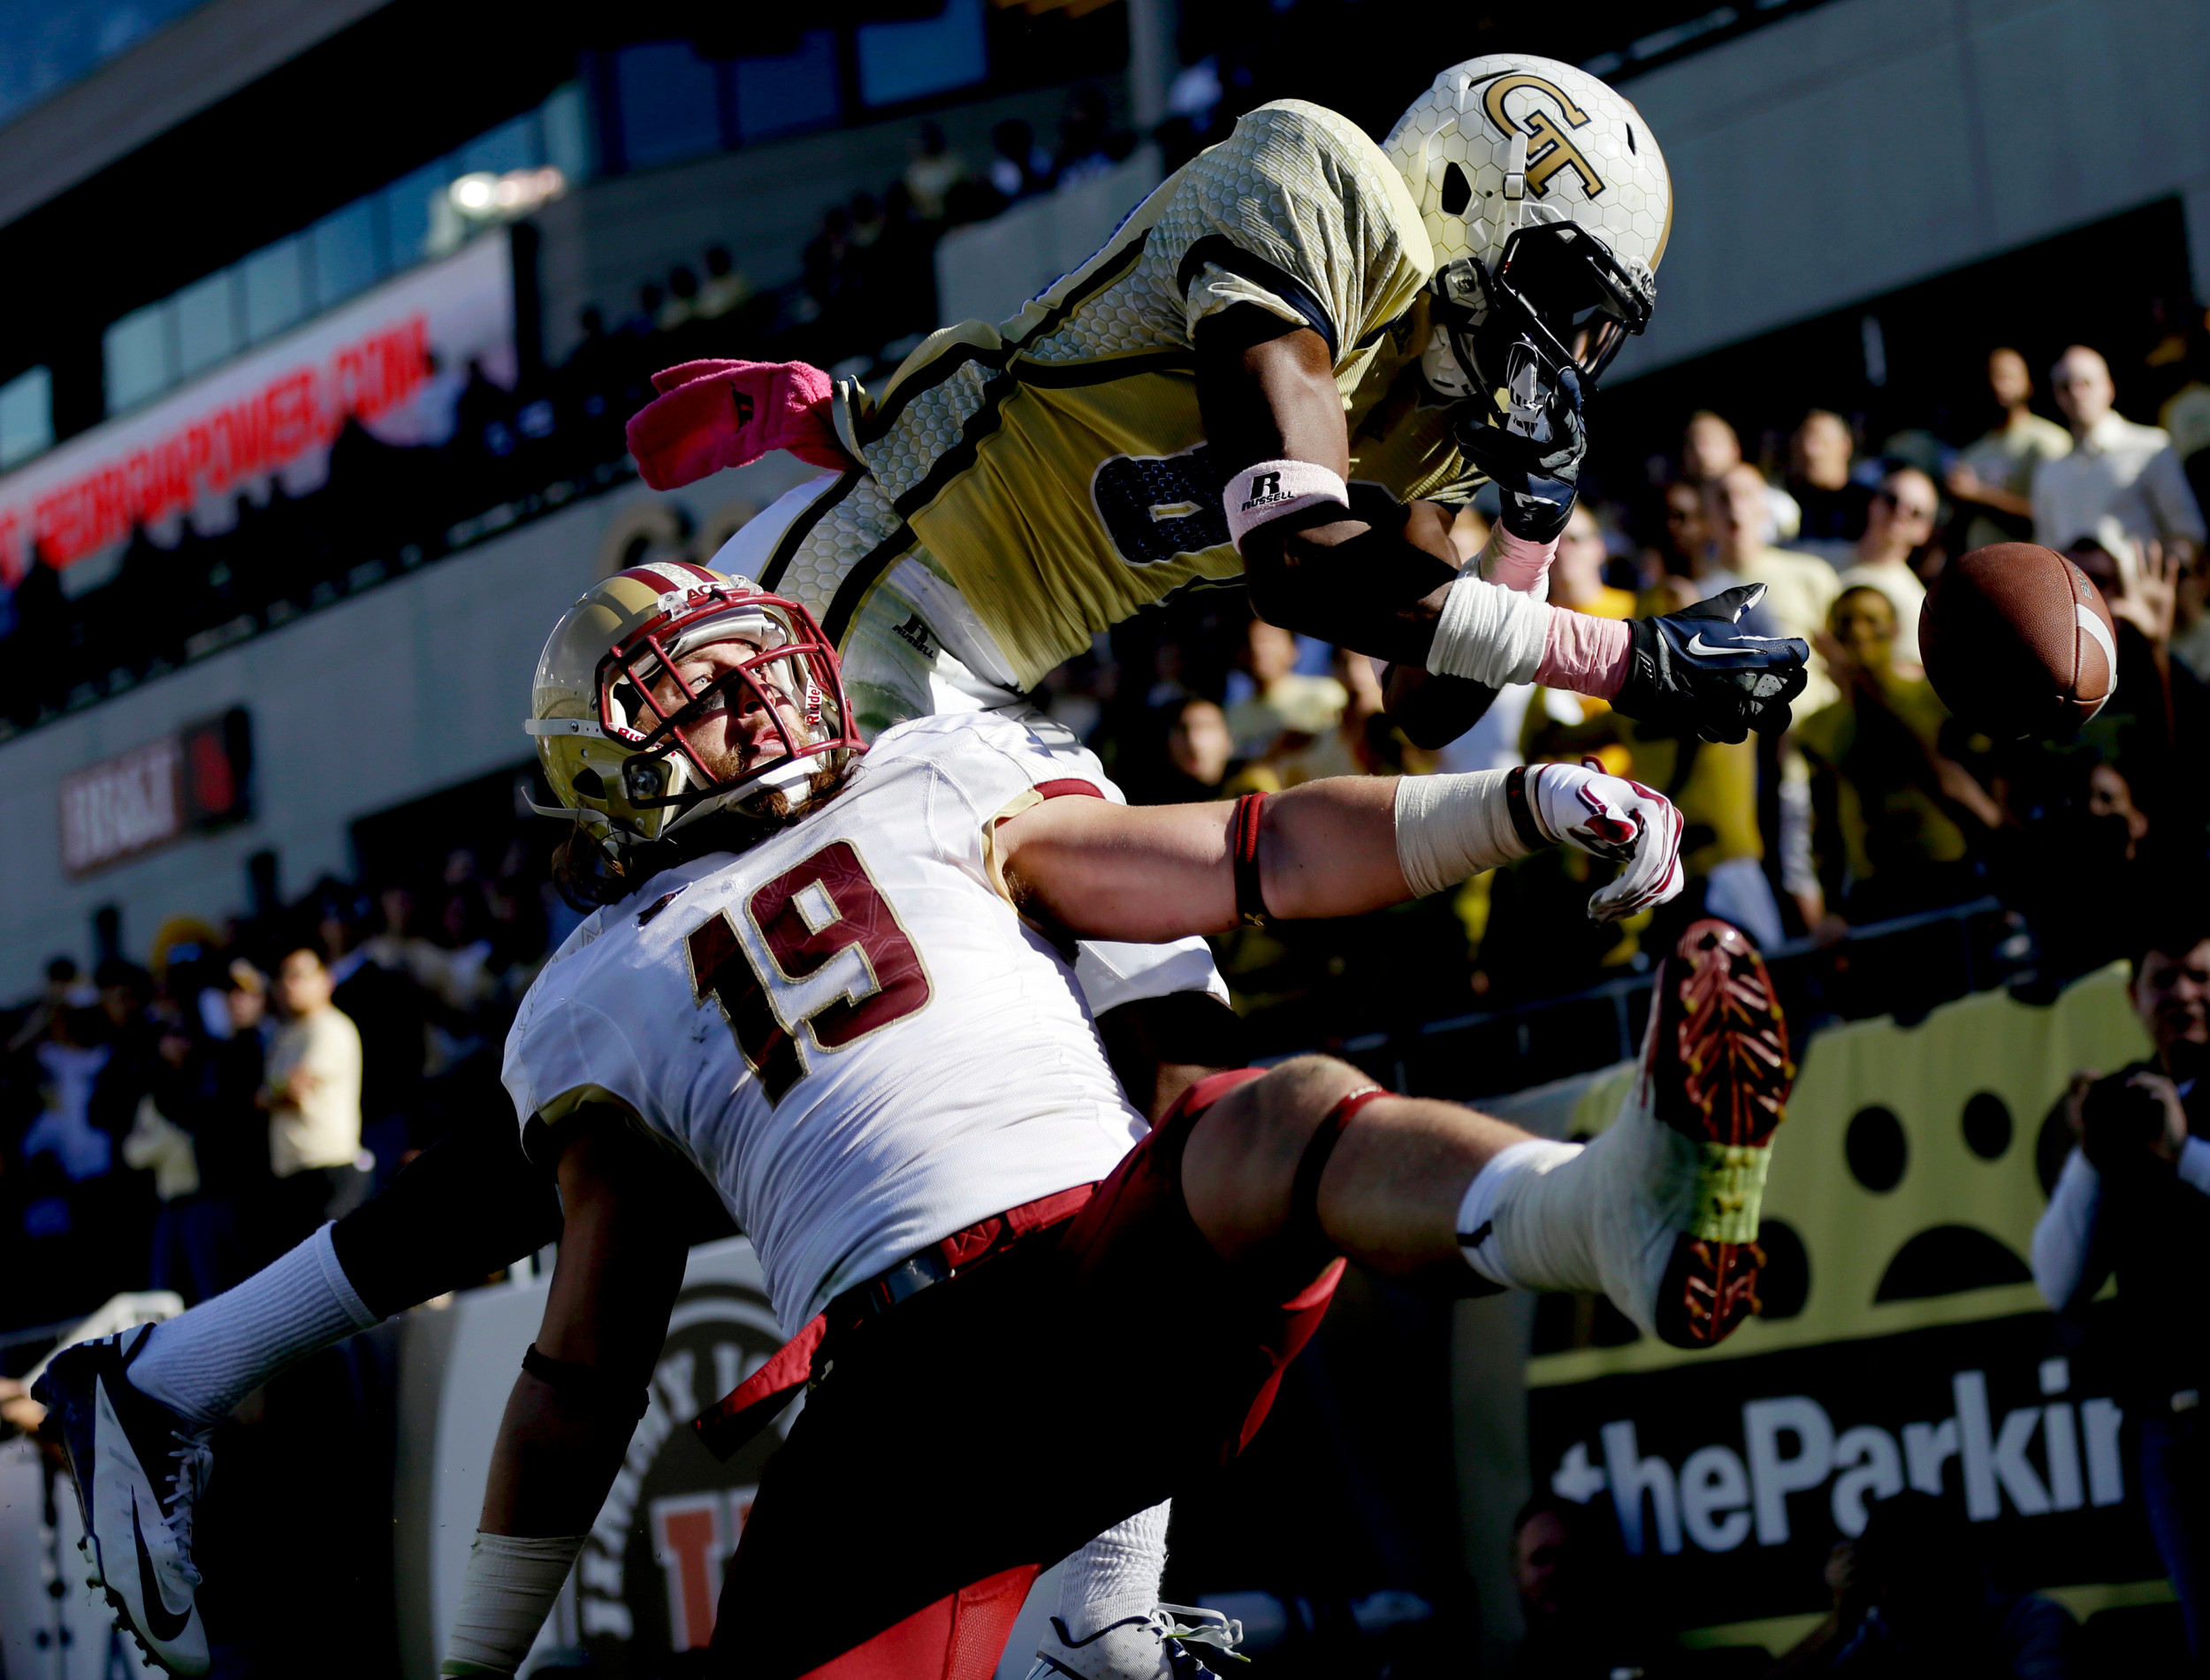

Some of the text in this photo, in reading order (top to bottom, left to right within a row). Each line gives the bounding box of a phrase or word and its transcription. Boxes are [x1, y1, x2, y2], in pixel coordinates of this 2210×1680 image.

[1482, 74, 1606, 200] GT
[1241, 491, 1294, 512] RUSSELL
[892, 624, 934, 659] RUSSELL
[682, 838, 935, 1111] 19
